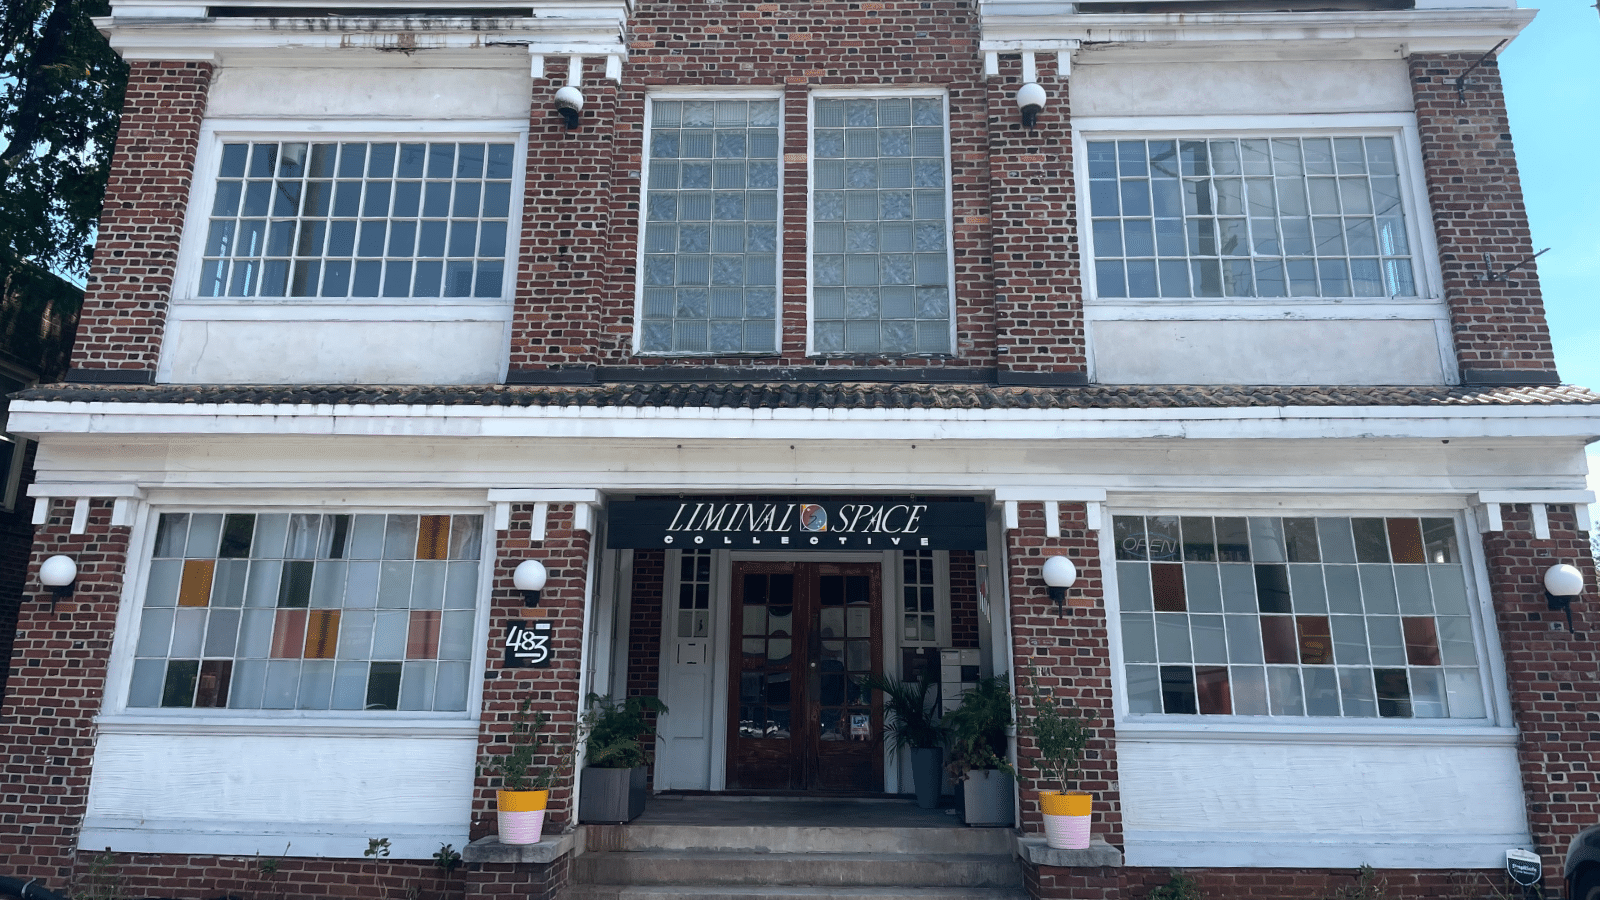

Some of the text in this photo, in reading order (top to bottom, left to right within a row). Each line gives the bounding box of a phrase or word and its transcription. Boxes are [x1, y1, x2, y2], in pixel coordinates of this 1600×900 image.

[665, 503, 928, 534] LIMINAL SPACE
[664, 535, 929, 546] COLLECTIVE
[1122, 537, 1177, 554] OPEN
[505, 625, 549, 664] 483
